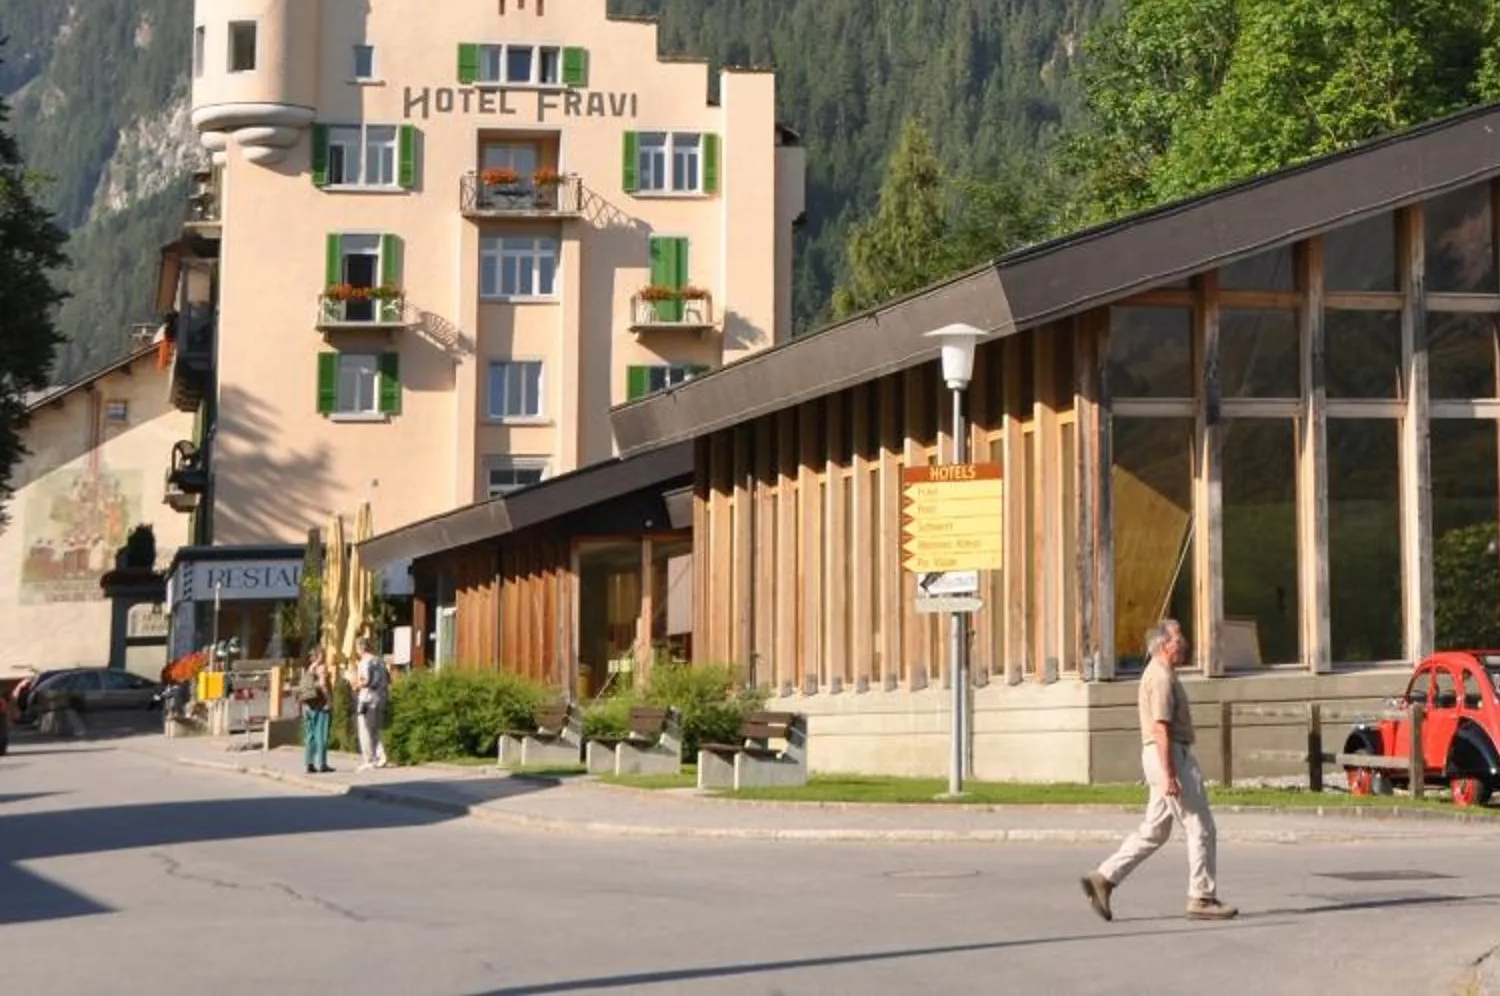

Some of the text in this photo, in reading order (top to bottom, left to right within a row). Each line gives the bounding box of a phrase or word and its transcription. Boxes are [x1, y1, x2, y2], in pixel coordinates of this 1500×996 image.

[403, 86, 638, 122] HOTEL FRAVI
[929, 465, 976, 481] HOTELS
